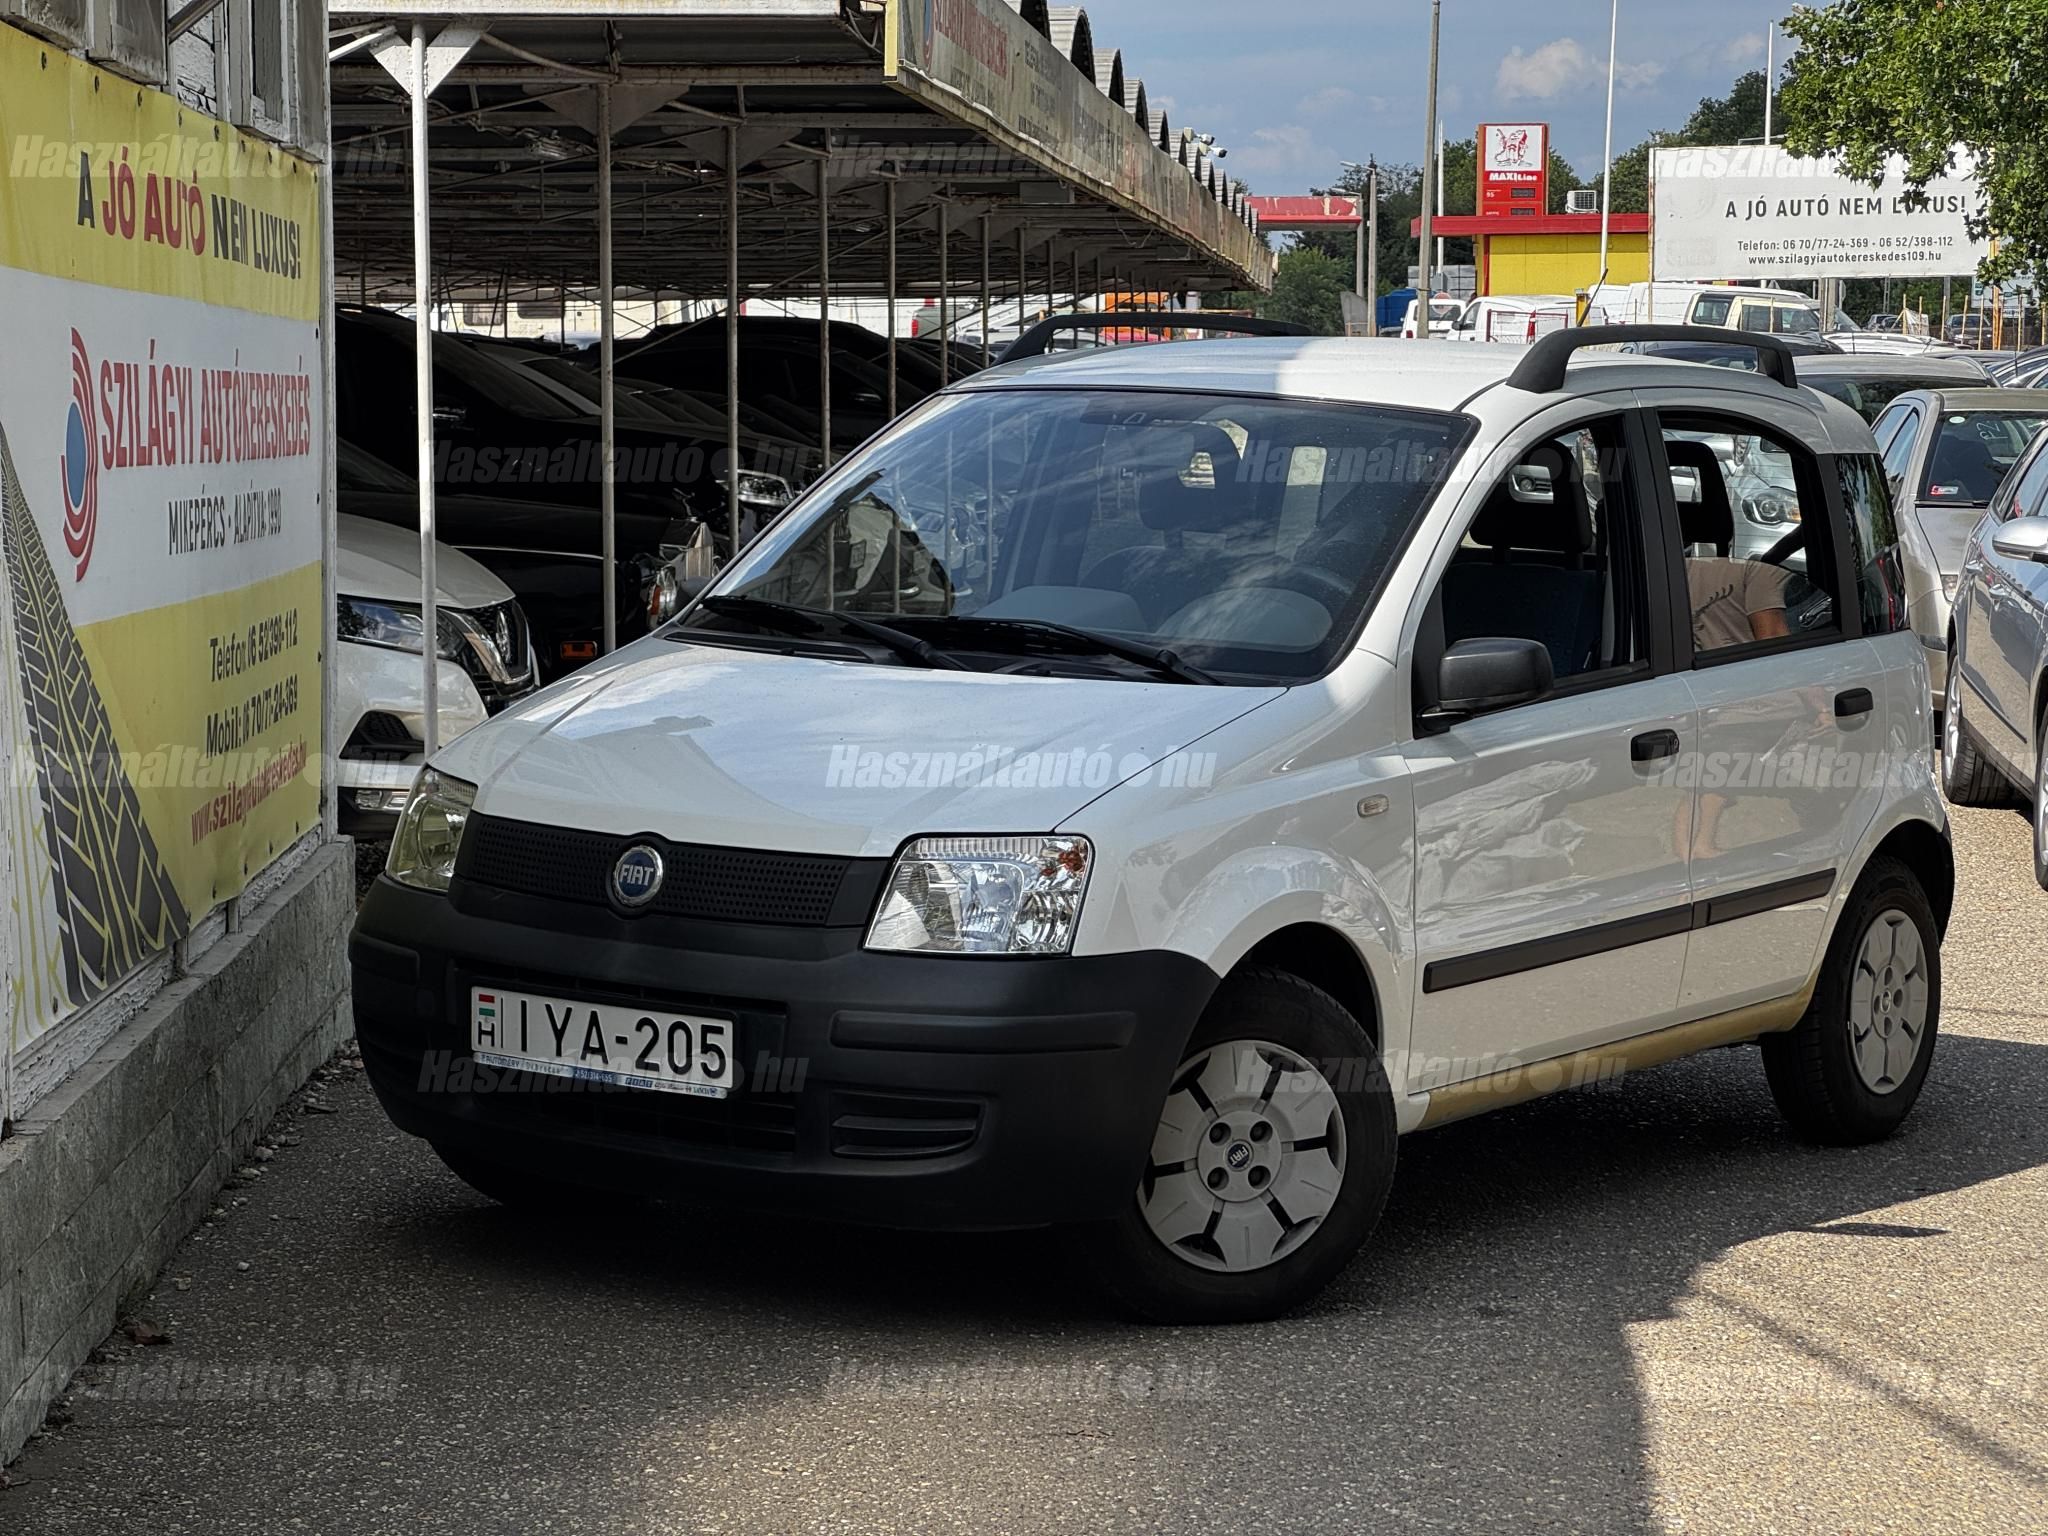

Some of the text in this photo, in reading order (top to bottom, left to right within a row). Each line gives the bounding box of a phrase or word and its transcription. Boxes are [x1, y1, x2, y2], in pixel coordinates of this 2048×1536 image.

[77, 146, 301, 280] A JÓ AUTÓ NEM LUXUS!
[1725, 201, 1737, 218] A
[1745, 195, 1767, 221] JÓ
[1776, 194, 1829, 217] AUTÓ
[1839, 197, 1882, 215] NEM
[1738, 236, 1953, 251] Telefon: 06 70/77-24-369 06 52/398-112
[1748, 251, 1942, 265] www.szilagyiautokereskedes109.hu
[100, 339, 311, 470] SZILÁGYI AUTÓKERESKEDÉS
[168, 483, 226, 556] MIKEPÉRCS
[206, 705, 242, 759] Mobil:
[620, 864, 655, 886] FIAT
[478, 1000, 727, 1079] H IYA-205
[1230, 1146, 1249, 1166] FIAT
